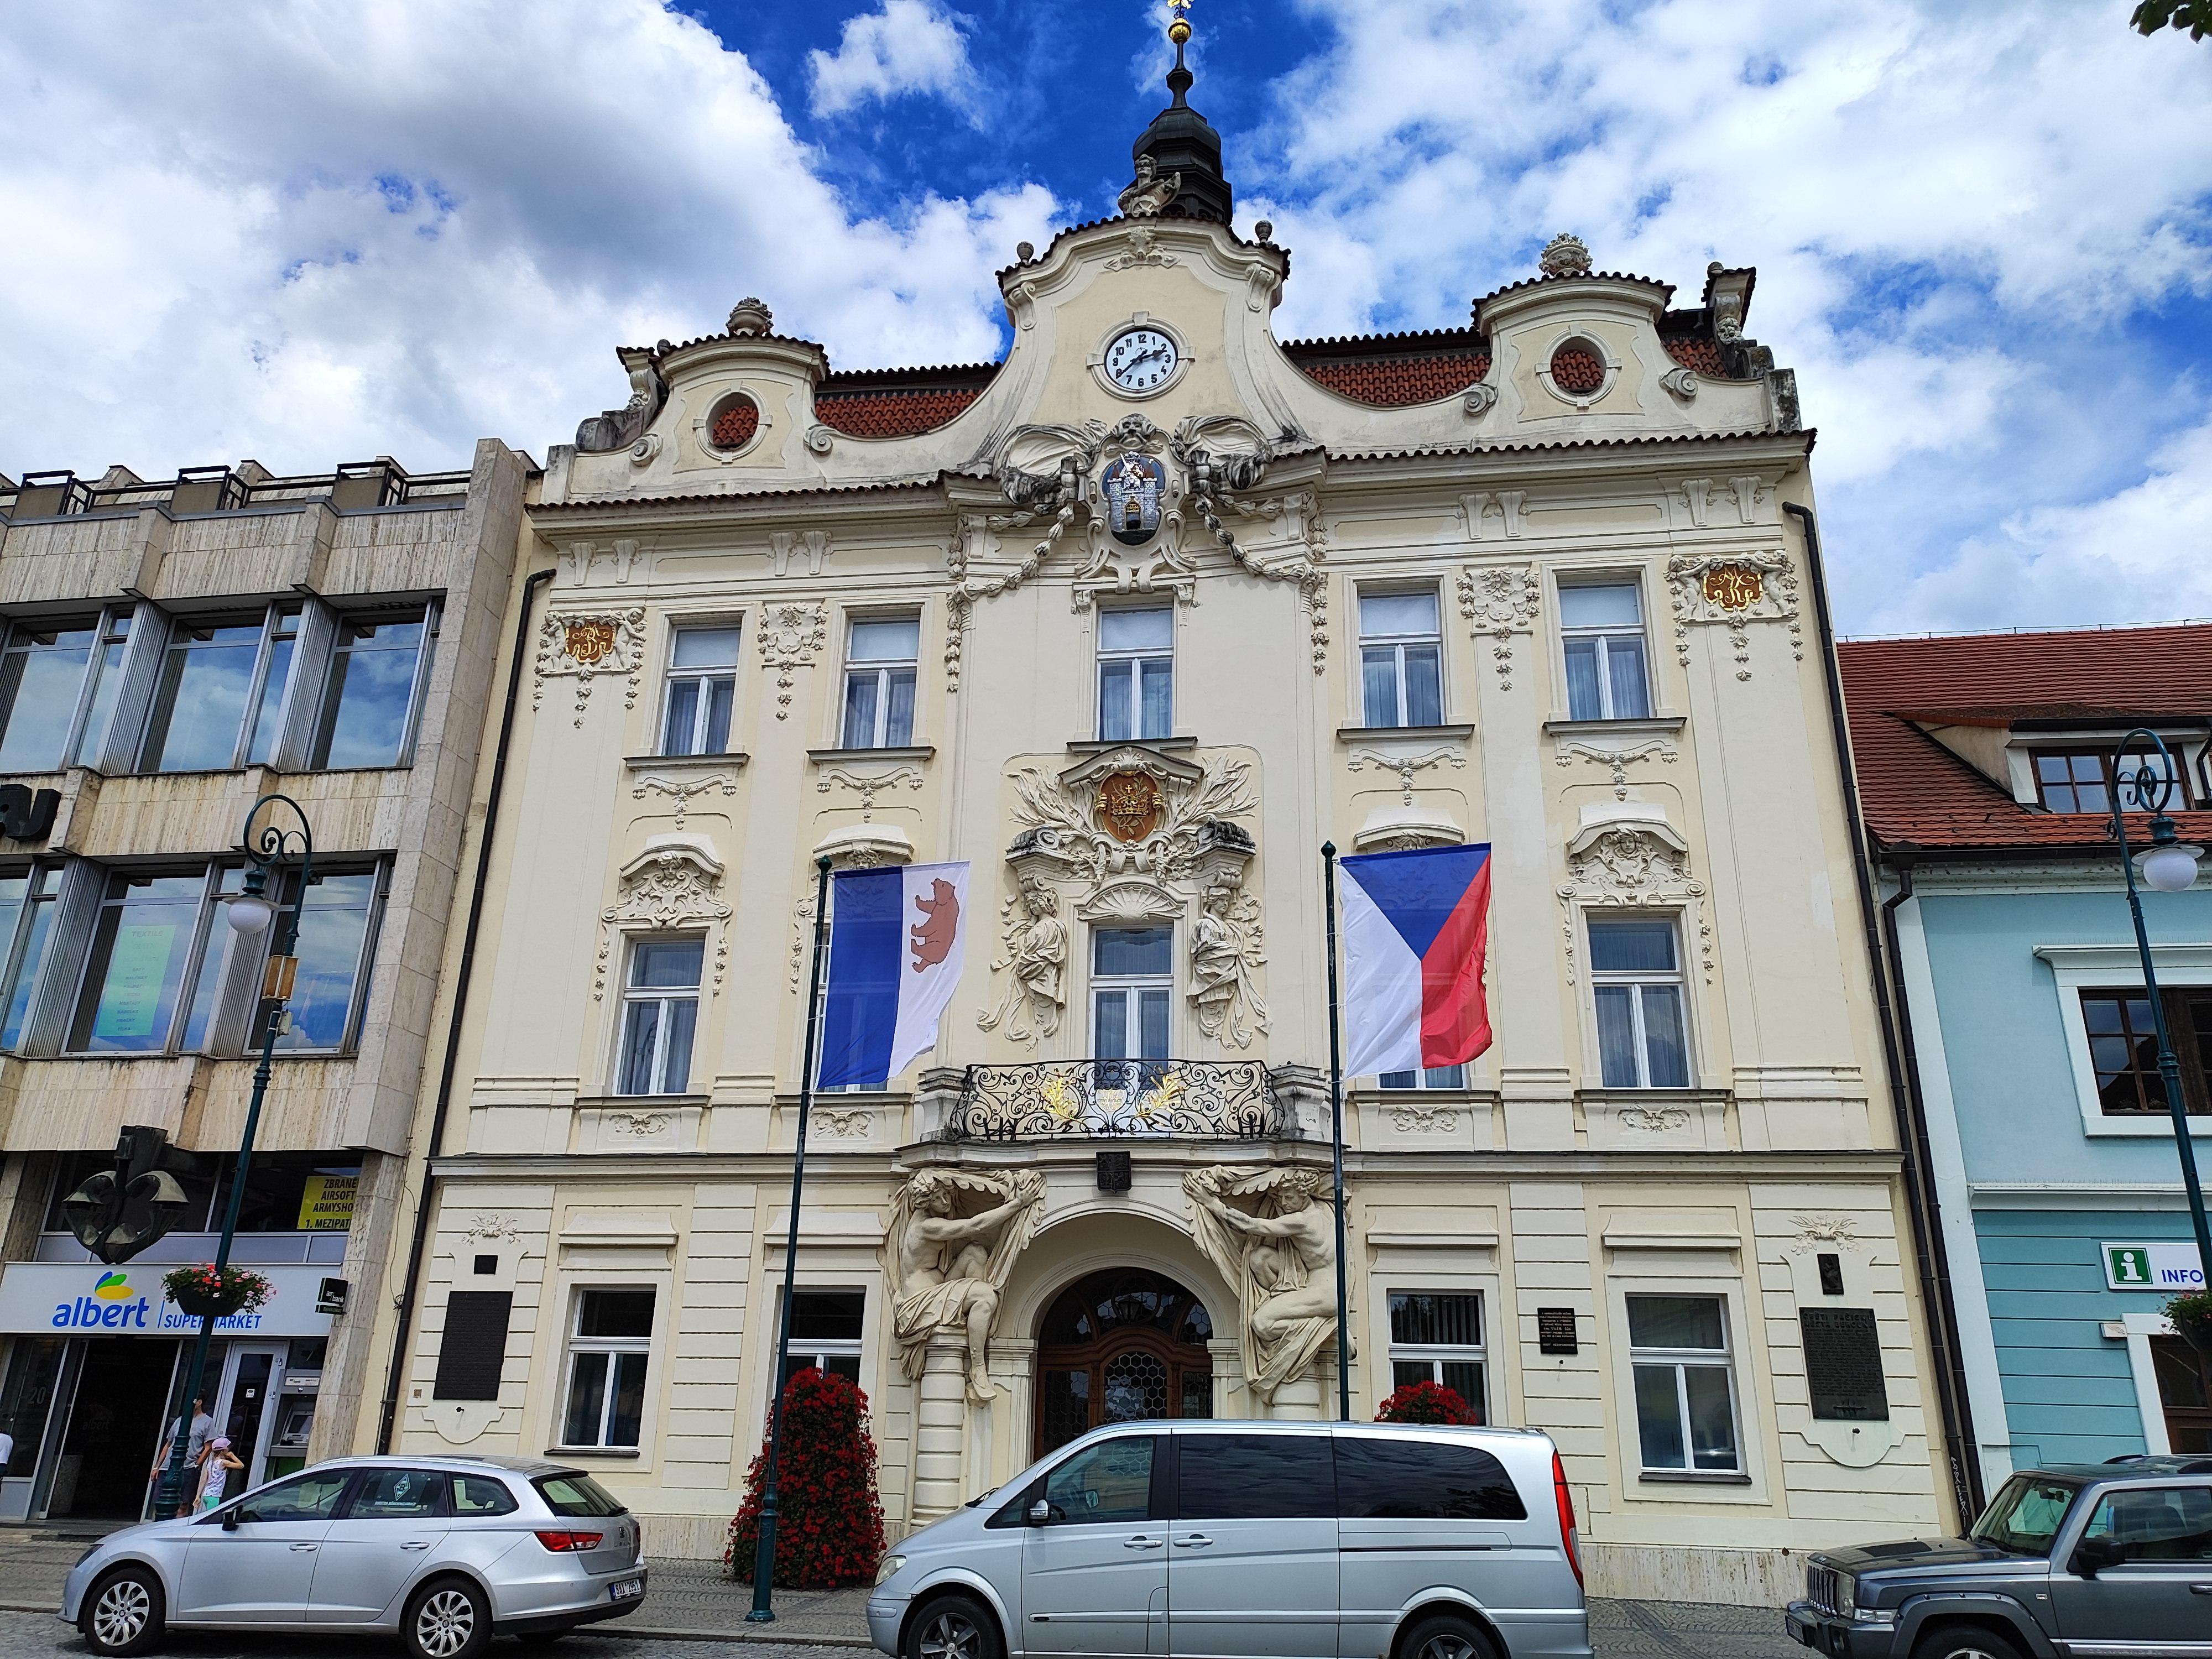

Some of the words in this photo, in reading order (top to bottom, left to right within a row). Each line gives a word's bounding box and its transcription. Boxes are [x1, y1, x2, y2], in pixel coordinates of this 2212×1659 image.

[1125, 338, 1132, 348] 11
[1138, 334, 1146, 343] 12
[1152, 336, 1155, 345] 1
[1115, 347, 1124, 356] 10
[1161, 343, 1167, 352] 2
[1113, 357, 1118, 366] 9
[1165, 354, 1171, 363] 3
[1161, 366, 1167, 375] 4
[1126, 375, 1132, 385] 7
[1138, 378, 1144, 387] 6
[1151, 374, 1157, 383] 5
[321, 1191, 356, 1200] AIRSOFT
[306, 1219, 312, 1228] 1.
[314, 1218, 352, 1228] MEZIPAT
[2161, 1269, 2204, 1283] INFO
[52, 1296, 149, 1328] albert
[164, 1314, 262, 1329] SUPERARKET
[28, 1386, 46, 1405] 20
